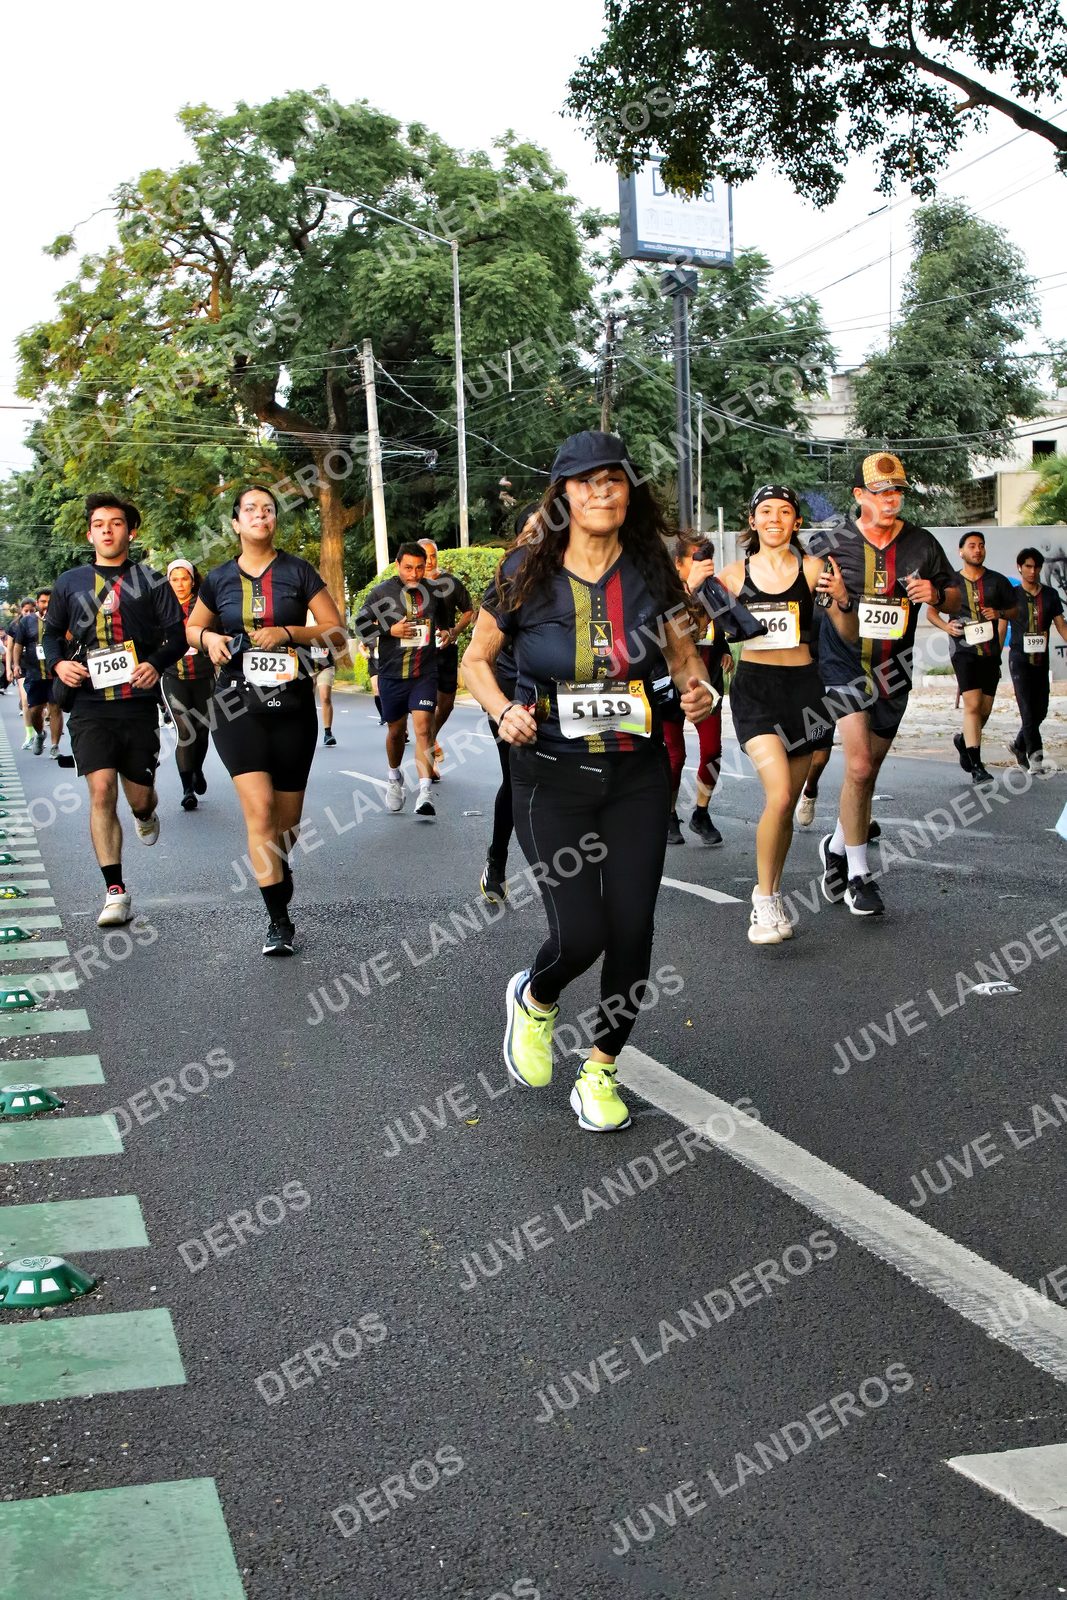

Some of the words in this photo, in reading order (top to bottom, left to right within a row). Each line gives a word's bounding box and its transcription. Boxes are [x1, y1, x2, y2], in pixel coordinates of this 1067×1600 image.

[864, 609, 898, 625] 2500
[975, 626, 984, 635] 93
[1027, 638, 1044, 646] 3999
[95, 656, 128, 675] 7568
[250, 656, 287, 672] 5825
[267, 697, 281, 707] alo
[572, 699, 632, 720] 5139
